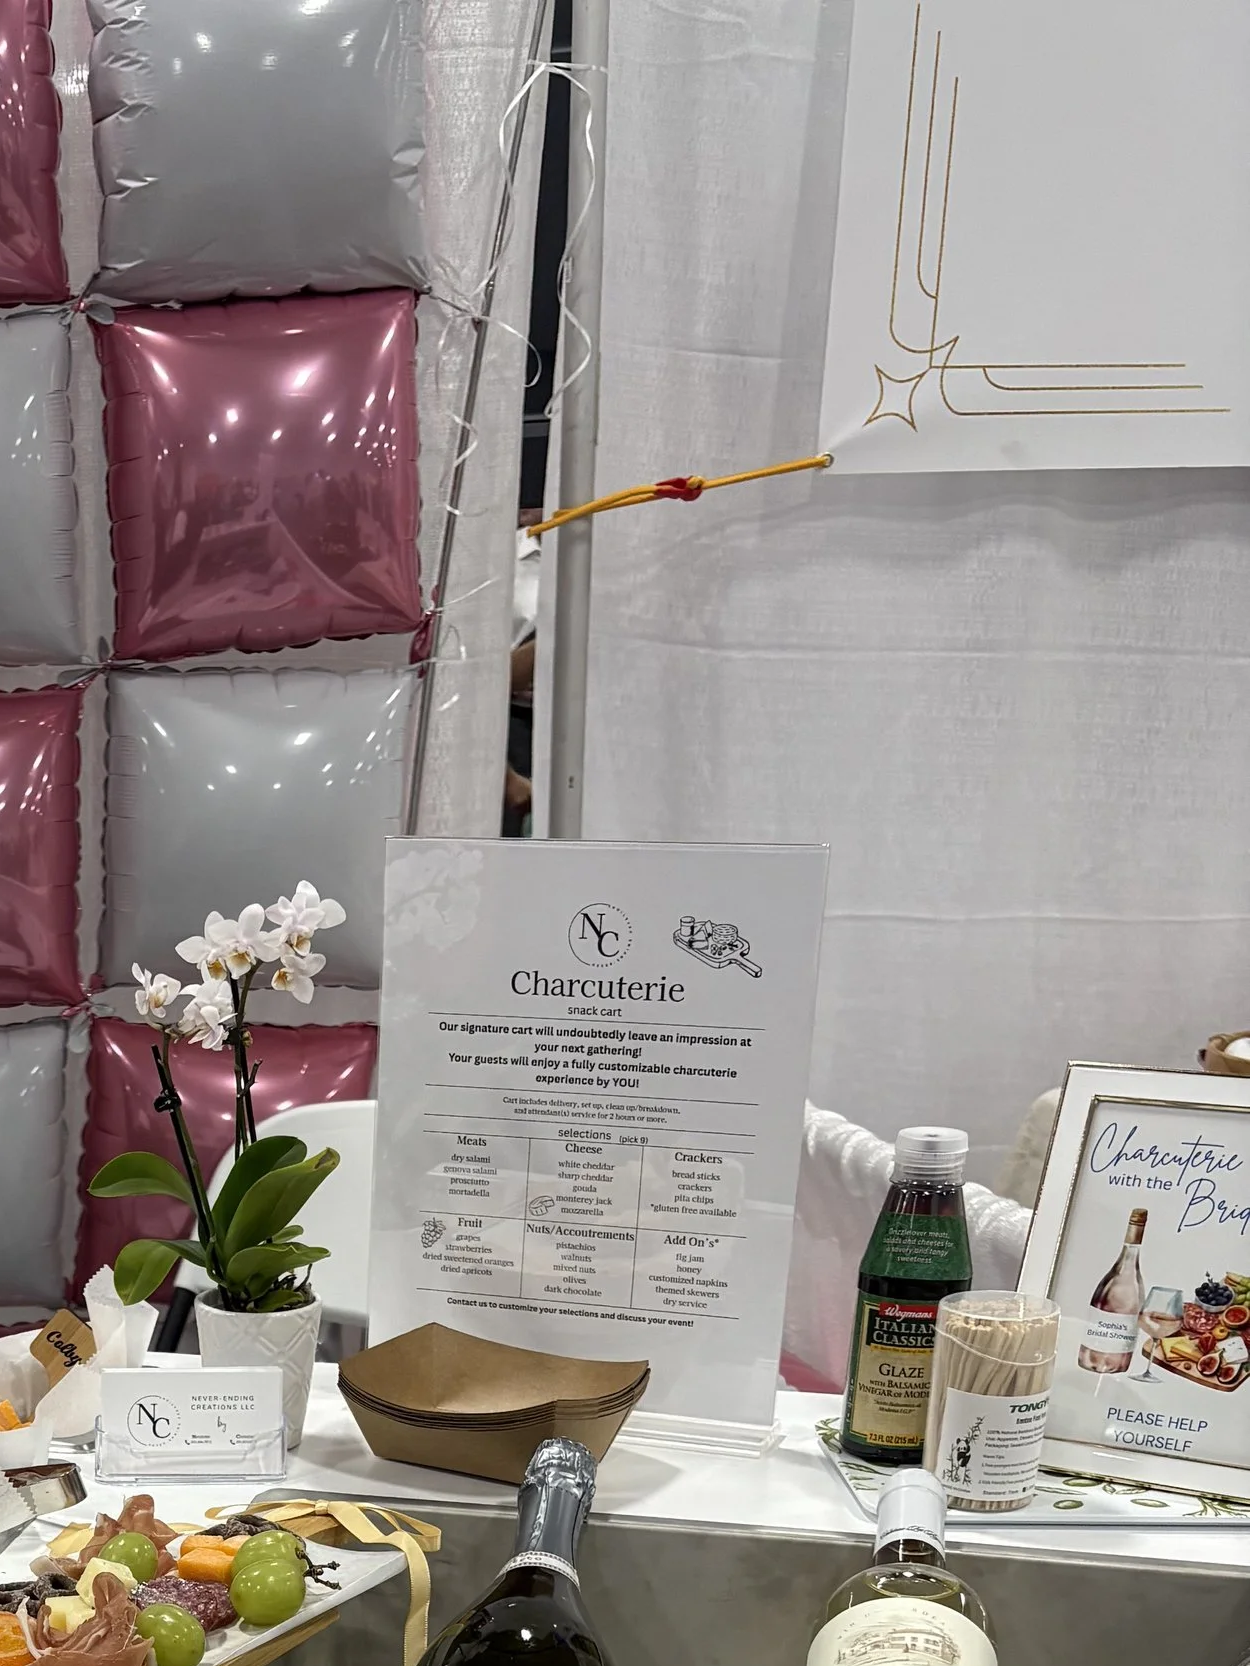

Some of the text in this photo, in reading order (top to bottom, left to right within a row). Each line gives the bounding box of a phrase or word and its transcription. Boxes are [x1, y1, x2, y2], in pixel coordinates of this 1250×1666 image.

[511, 970, 685, 1002] Charcuterie
[567, 1005, 622, 1017] snack cart
[439, 1021, 752, 1047] Our signature cart will undoubtedly leave an impression at
[534, 1043, 642, 1059] your next gathering!
[448, 1052, 737, 1078] Your guests will enjoy a fully customizable charcuterie
[535, 1074, 639, 1088] experience by YOU!
[558, 1129, 611, 1140] selections
[457, 1136, 487, 1146] Meats
[565, 1143, 602, 1154] Cheese
[1090, 1122, 1243, 1186] Charcuterie
[451, 1154, 464, 1163] dry
[674, 1151, 723, 1164] Crackers
[558, 1159, 616, 1170] white cheddar
[558, 1170, 614, 1182] sharp cheddar
[672, 1169, 721, 1181] bread sticks
[451, 1178, 490, 1186] prosciutto
[677, 1183, 713, 1192] crackers
[1108, 1173, 1173, 1191] with the
[449, 1189, 490, 1197] mortadella
[572, 1185, 597, 1193] gouda
[556, 1195, 613, 1206] monterey jack
[674, 1193, 714, 1205] pita chips
[560, 1207, 604, 1216] mozzarella
[681, 1205, 698, 1214] free
[699, 1208, 737, 1217] available
[458, 1217, 483, 1228] Fruit
[455, 1234, 482, 1243] grapes
[526, 1224, 635, 1241] Nuts/Accoutrements
[556, 1242, 596, 1251] pistachios
[664, 1235, 687, 1246] Add
[422, 1251, 514, 1267] dried sweetened oranges
[561, 1254, 592, 1262] walnuts
[688, 1253, 705, 1262] jam
[440, 1264, 493, 1276] dried apricots
[553, 1263, 596, 1274] mixed nuts
[676, 1264, 703, 1276] honey
[562, 1275, 587, 1284] olives
[648, 1274, 728, 1287] customized napkins
[544, 1284, 602, 1296] dark chocolate
[655, 1285, 720, 1298] themed skewers
[662, 1297, 708, 1308] dry service
[447, 1296, 477, 1306] Contact
[498, 1303, 538, 1312] customize
[539, 1306, 557, 1314] your
[558, 1308, 599, 1318] selections
[616, 1312, 647, 1322] discuss
[668, 1319, 694, 1327] event!
[885, 1305, 933, 1321] Wegmans
[46, 1331, 82, 1367] Colby
[879, 1363, 924, 1378] GLAZE
[858, 1383, 893, 1398] VINEGAR
[1107, 1407, 1208, 1432] PLEASE HELP
[869, 1433, 877, 1442] 7.3
[878, 1434, 885, 1442] FL
[1114, 1430, 1193, 1452] YOURSELF
